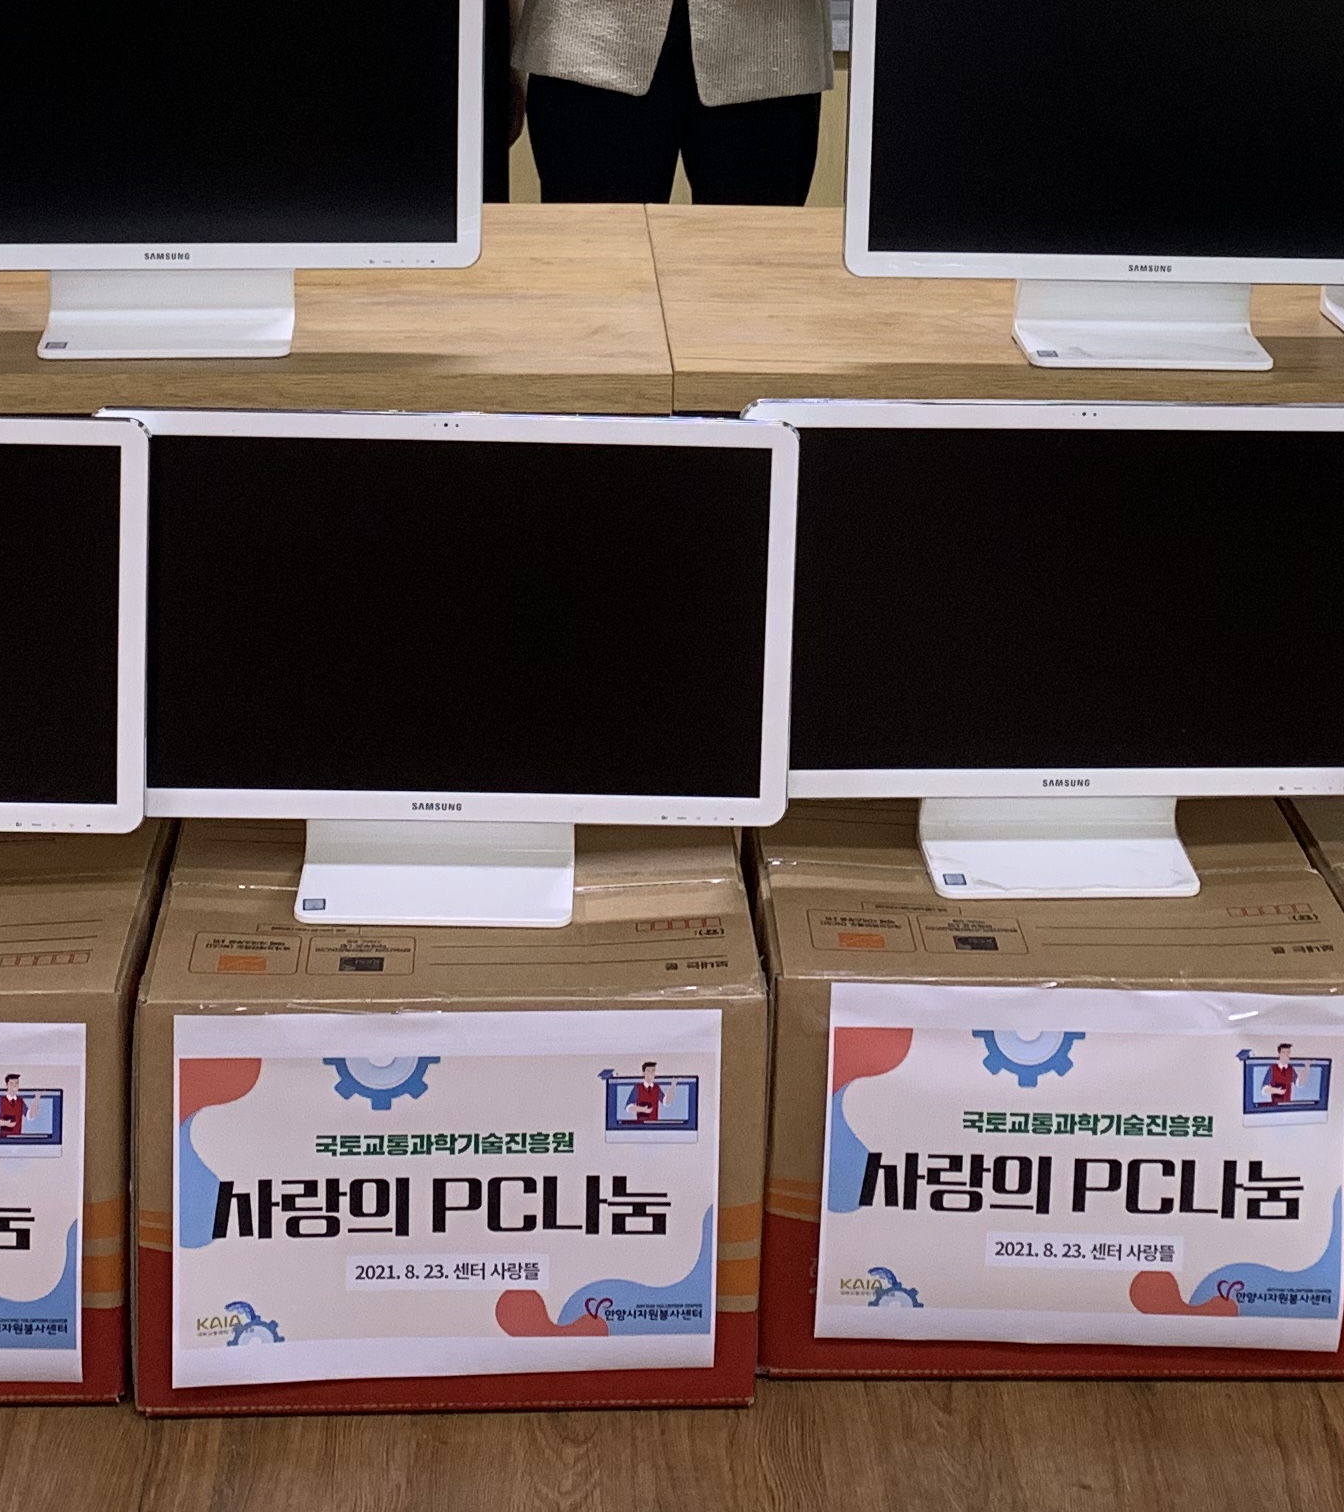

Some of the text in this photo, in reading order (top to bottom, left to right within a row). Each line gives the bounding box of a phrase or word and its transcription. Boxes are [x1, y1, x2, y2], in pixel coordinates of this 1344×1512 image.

[144, 252, 190, 261] SAMSUNG
[1128, 264, 1172, 273] SAMSUNG
[1042, 778, 1091, 788] SAMSUNG
[411, 802, 462, 812] SAMSUNG
[961, 1110, 1214, 1139] 국토교통과학기술진흥원
[314, 1131, 575, 1158] 국토교통과학기술진흥원
[857, 1151, 1305, 1221] 사랑의 PC나눔
[210, 1174, 671, 1240] 사랑의 PC나눔
[994, 1241, 1176, 1263] 2021. 8. 23. 센터 사랑뜰
[355, 1262, 541, 1281] 2021. 8. 23. 센터 사랑뜰
[839, 1277, 883, 1291] KAIA
[196, 1314, 242, 1331] KAIA
